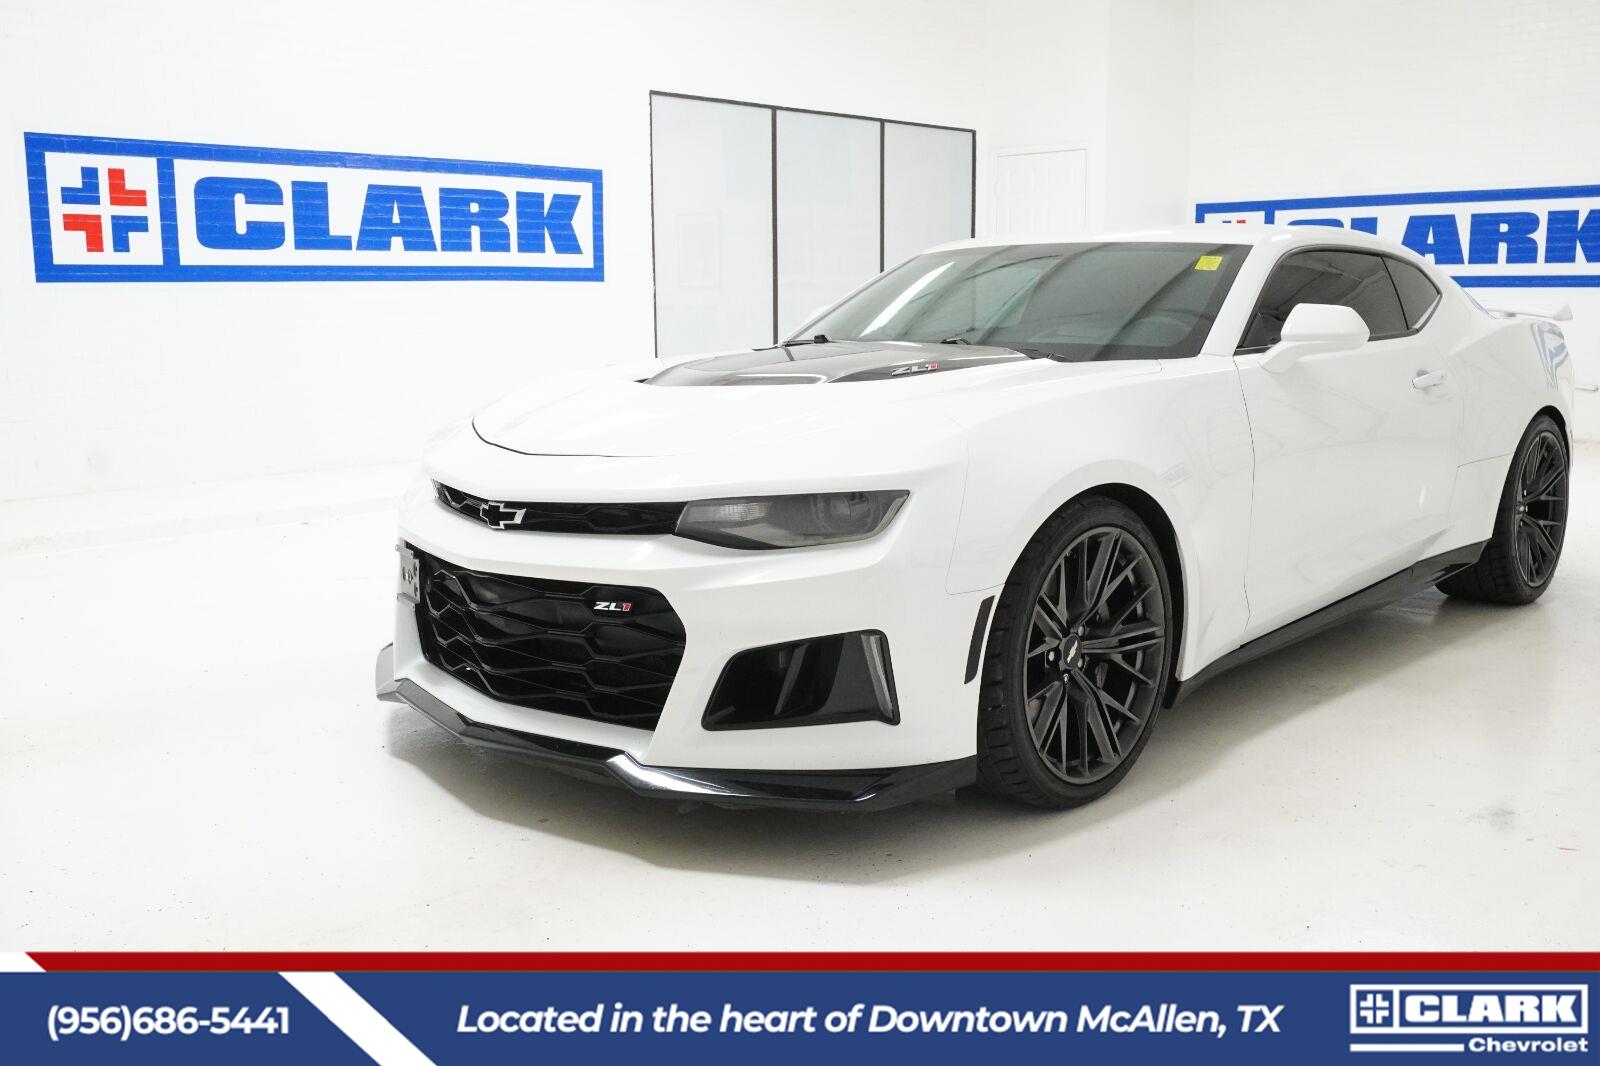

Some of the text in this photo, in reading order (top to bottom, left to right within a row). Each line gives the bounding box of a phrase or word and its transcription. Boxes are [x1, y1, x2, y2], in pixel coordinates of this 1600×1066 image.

[194, 176, 584, 254] CLARK
[1287, 208, 1600, 265] ARK
[891, 363, 938, 376] ZL1
[593, 601, 632, 612] ZL1
